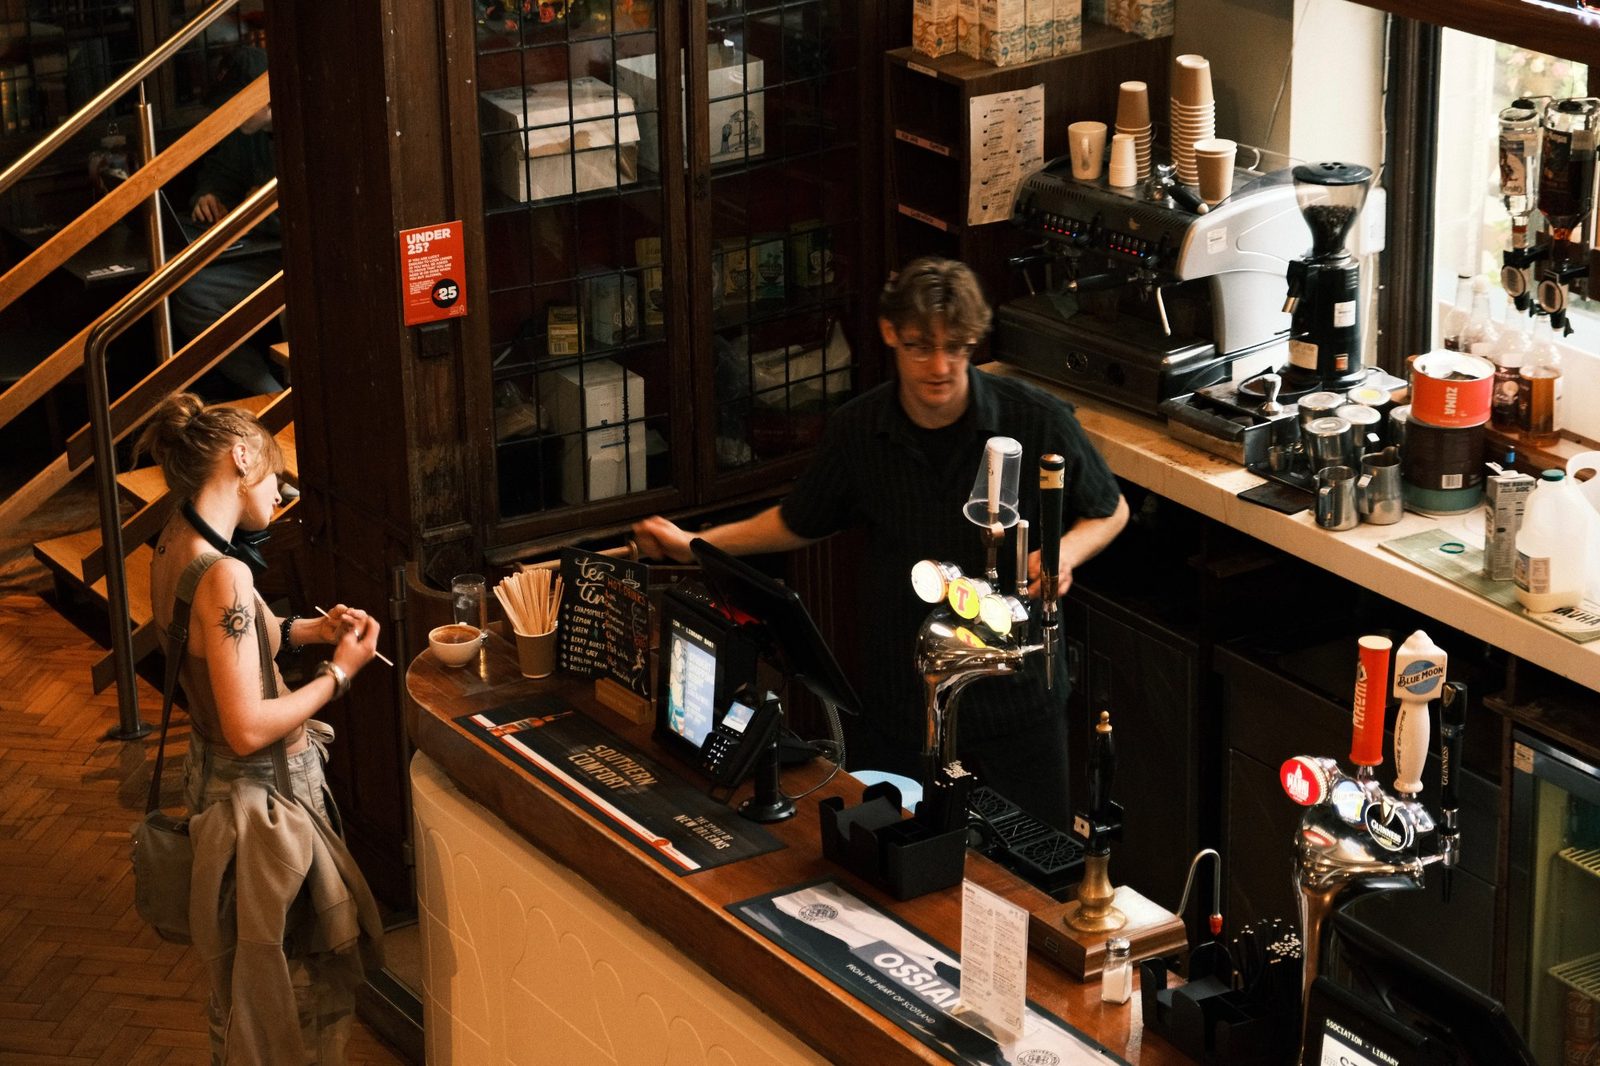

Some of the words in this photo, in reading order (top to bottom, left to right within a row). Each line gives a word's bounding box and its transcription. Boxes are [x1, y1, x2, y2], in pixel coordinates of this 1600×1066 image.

[406, 228, 451, 244] UNDER
[408, 242, 429, 255] 25?
[440, 286, 457, 300] 25
[1444, 386, 1458, 414] ZUMA
[956, 586, 969, 612] T
[572, 616, 591, 625] LEMON
[574, 605, 606, 618] CHAMOMILE
[572, 626, 588, 634] GREEN
[685, 627, 703, 641] LIBRARY
[570, 645, 583, 653] EARL
[586, 649, 598, 657] GREY
[571, 636, 586, 645] BERRY
[589, 640, 605, 650] BURST
[1397, 674, 1420, 688] BLUE
[1421, 666, 1444, 680] MOON
[568, 753, 632, 789] COMFORT
[588, 744, 658, 786] SOUTHERN
[673, 814, 698, 827] NEW
[692, 826, 730, 850] ORLEANS
[694, 816, 710, 825] THE
[704, 823, 727, 836] SPIRIT
[1371, 819, 1402, 843] GUINNESS
[846, 964, 866, 977] FROM
[864, 974, 877, 985] THE
[874, 981, 896, 997] HEART
[893, 994, 905, 1003] OF
[902, 1001, 936, 1024] SCOTLAND
[1326, 1018, 1362, 1046] SSOCIATION
[1372, 1046, 1399, 1066] LIBRARY
